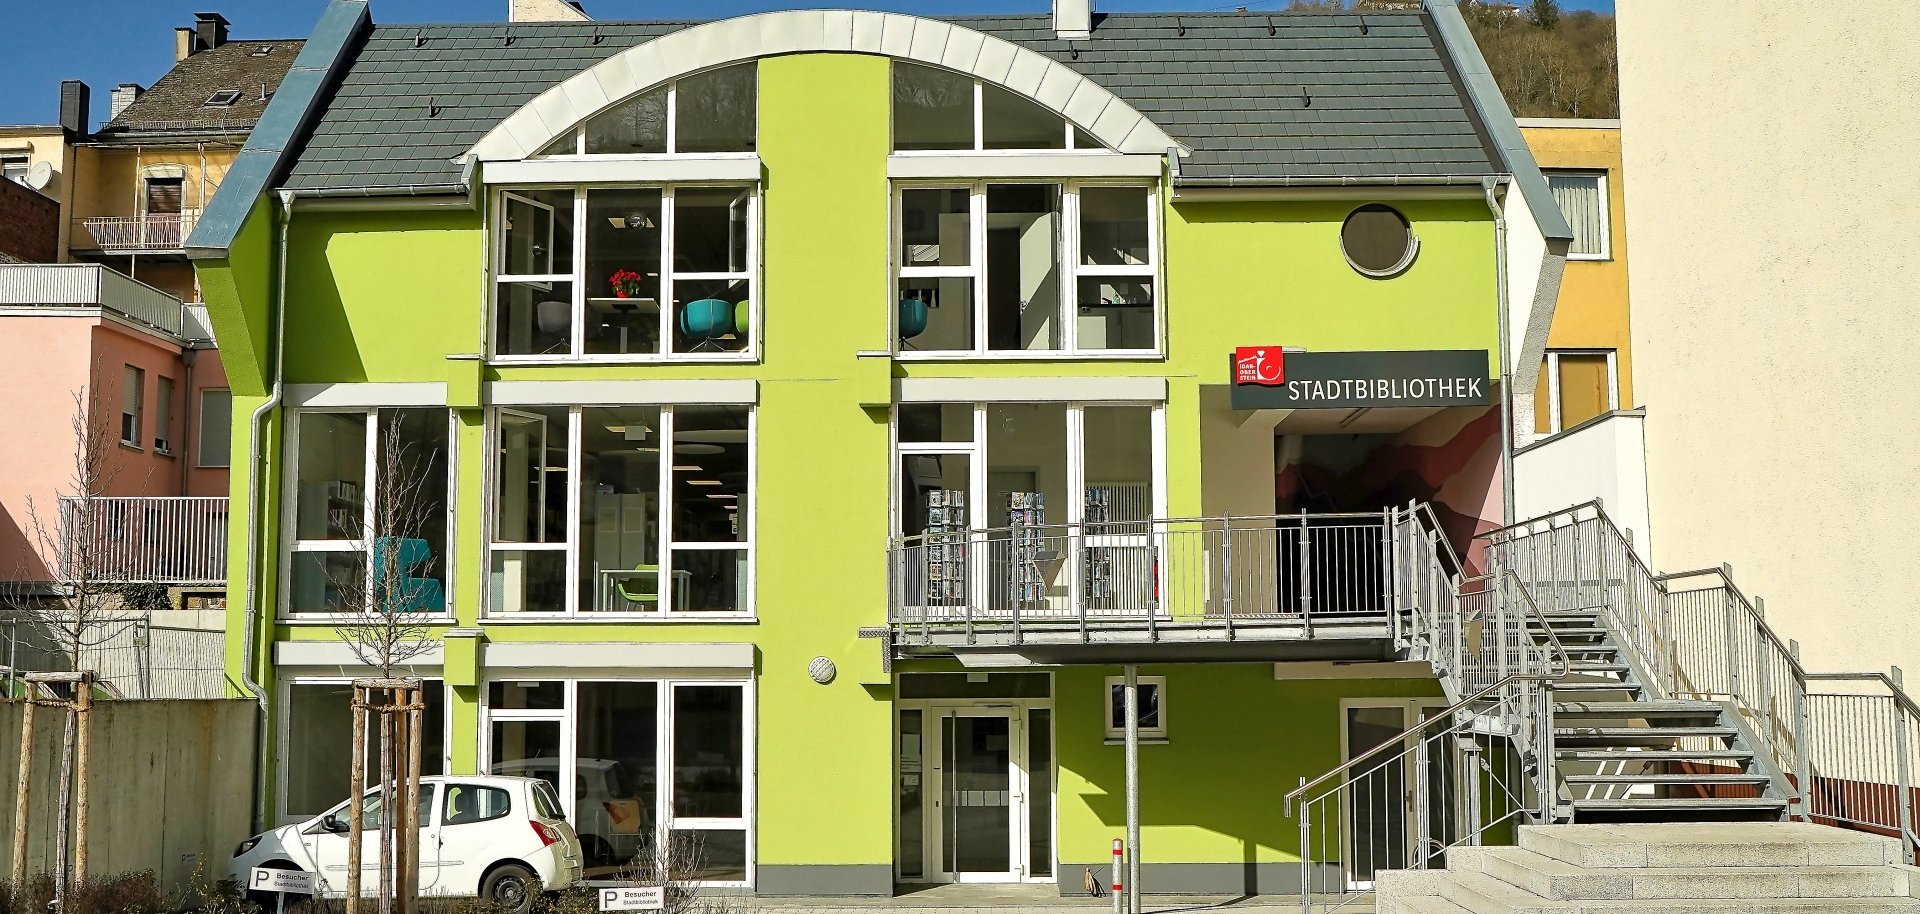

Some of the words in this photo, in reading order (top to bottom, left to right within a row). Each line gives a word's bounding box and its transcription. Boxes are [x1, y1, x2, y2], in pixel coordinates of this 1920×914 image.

[1288, 378, 1482, 400] STADTBIBLIOTHEK
[255, 870, 269, 887] P
[604, 891, 618, 908] P
